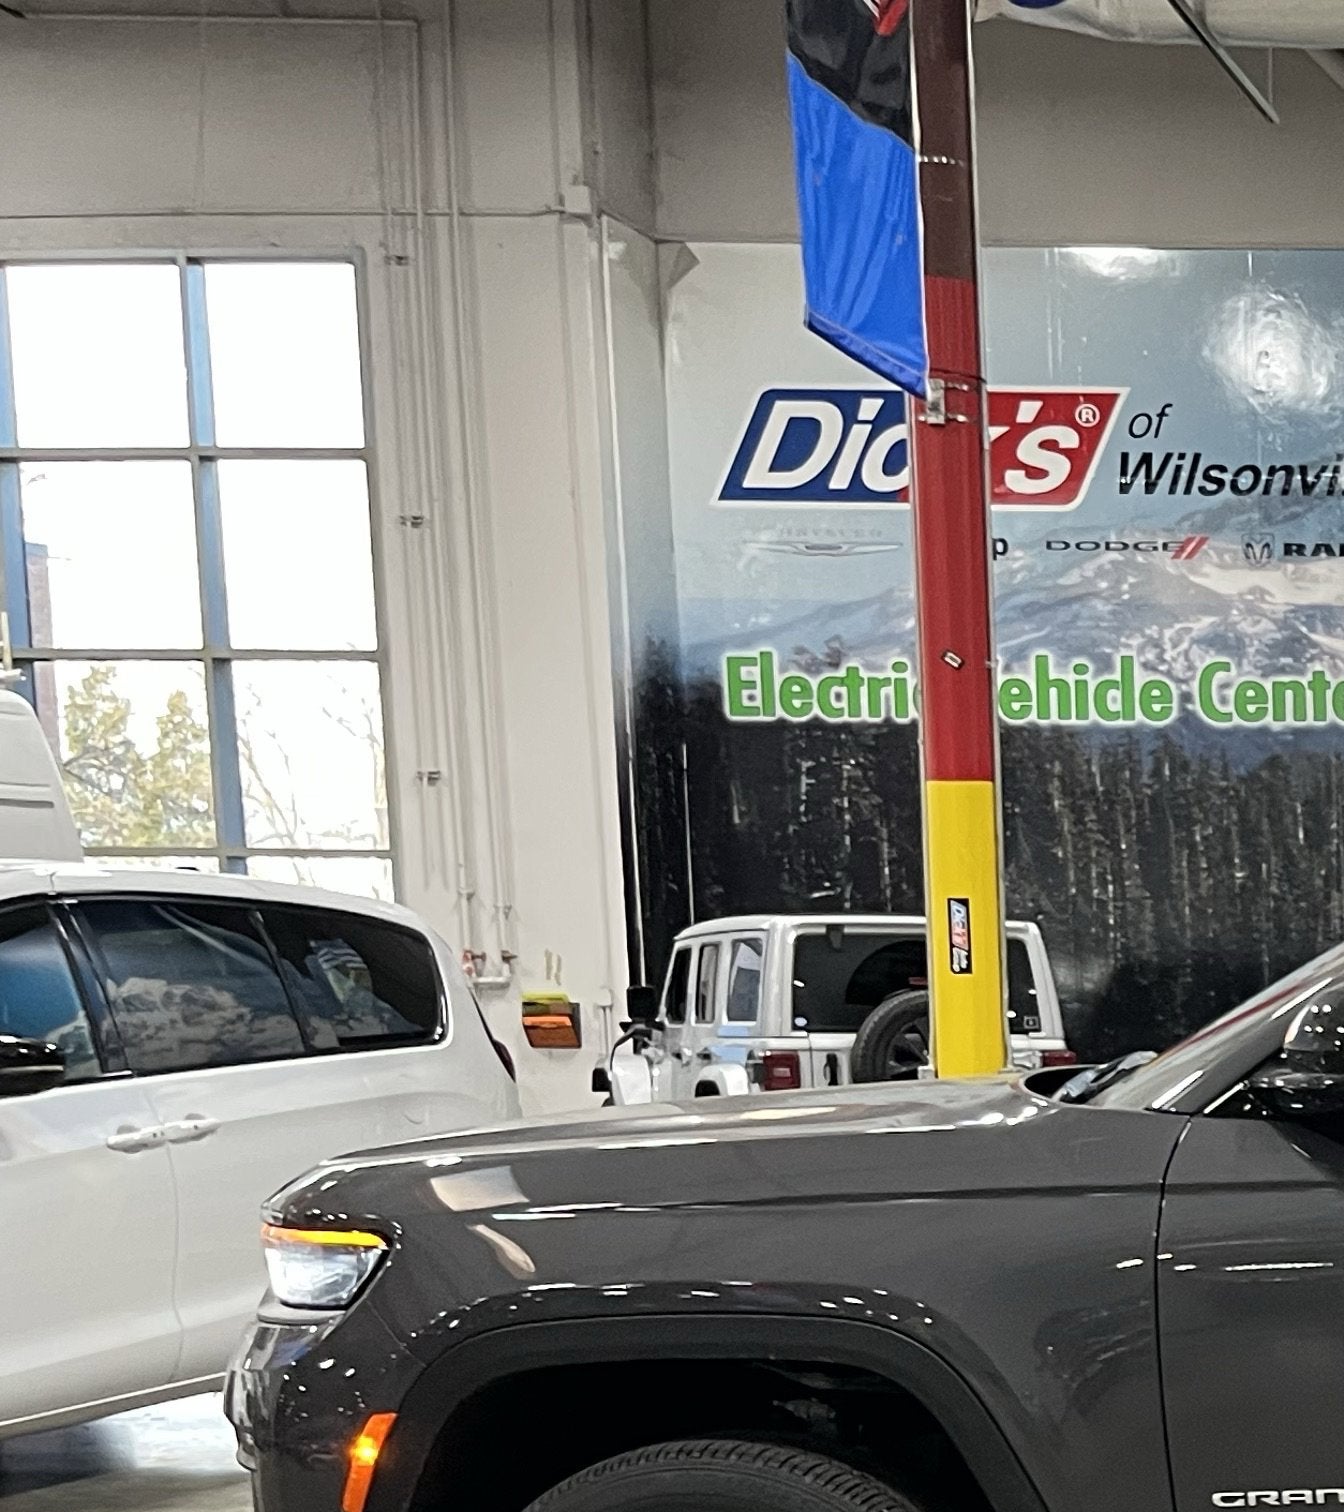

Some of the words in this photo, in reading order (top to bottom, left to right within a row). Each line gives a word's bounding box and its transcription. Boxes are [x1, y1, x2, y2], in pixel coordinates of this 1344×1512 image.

[1128, 403, 1173, 439] of
[1045, 540, 1184, 553] DODGE
[726, 651, 917, 719] Electri
[998, 655, 1173, 723] ehicle
